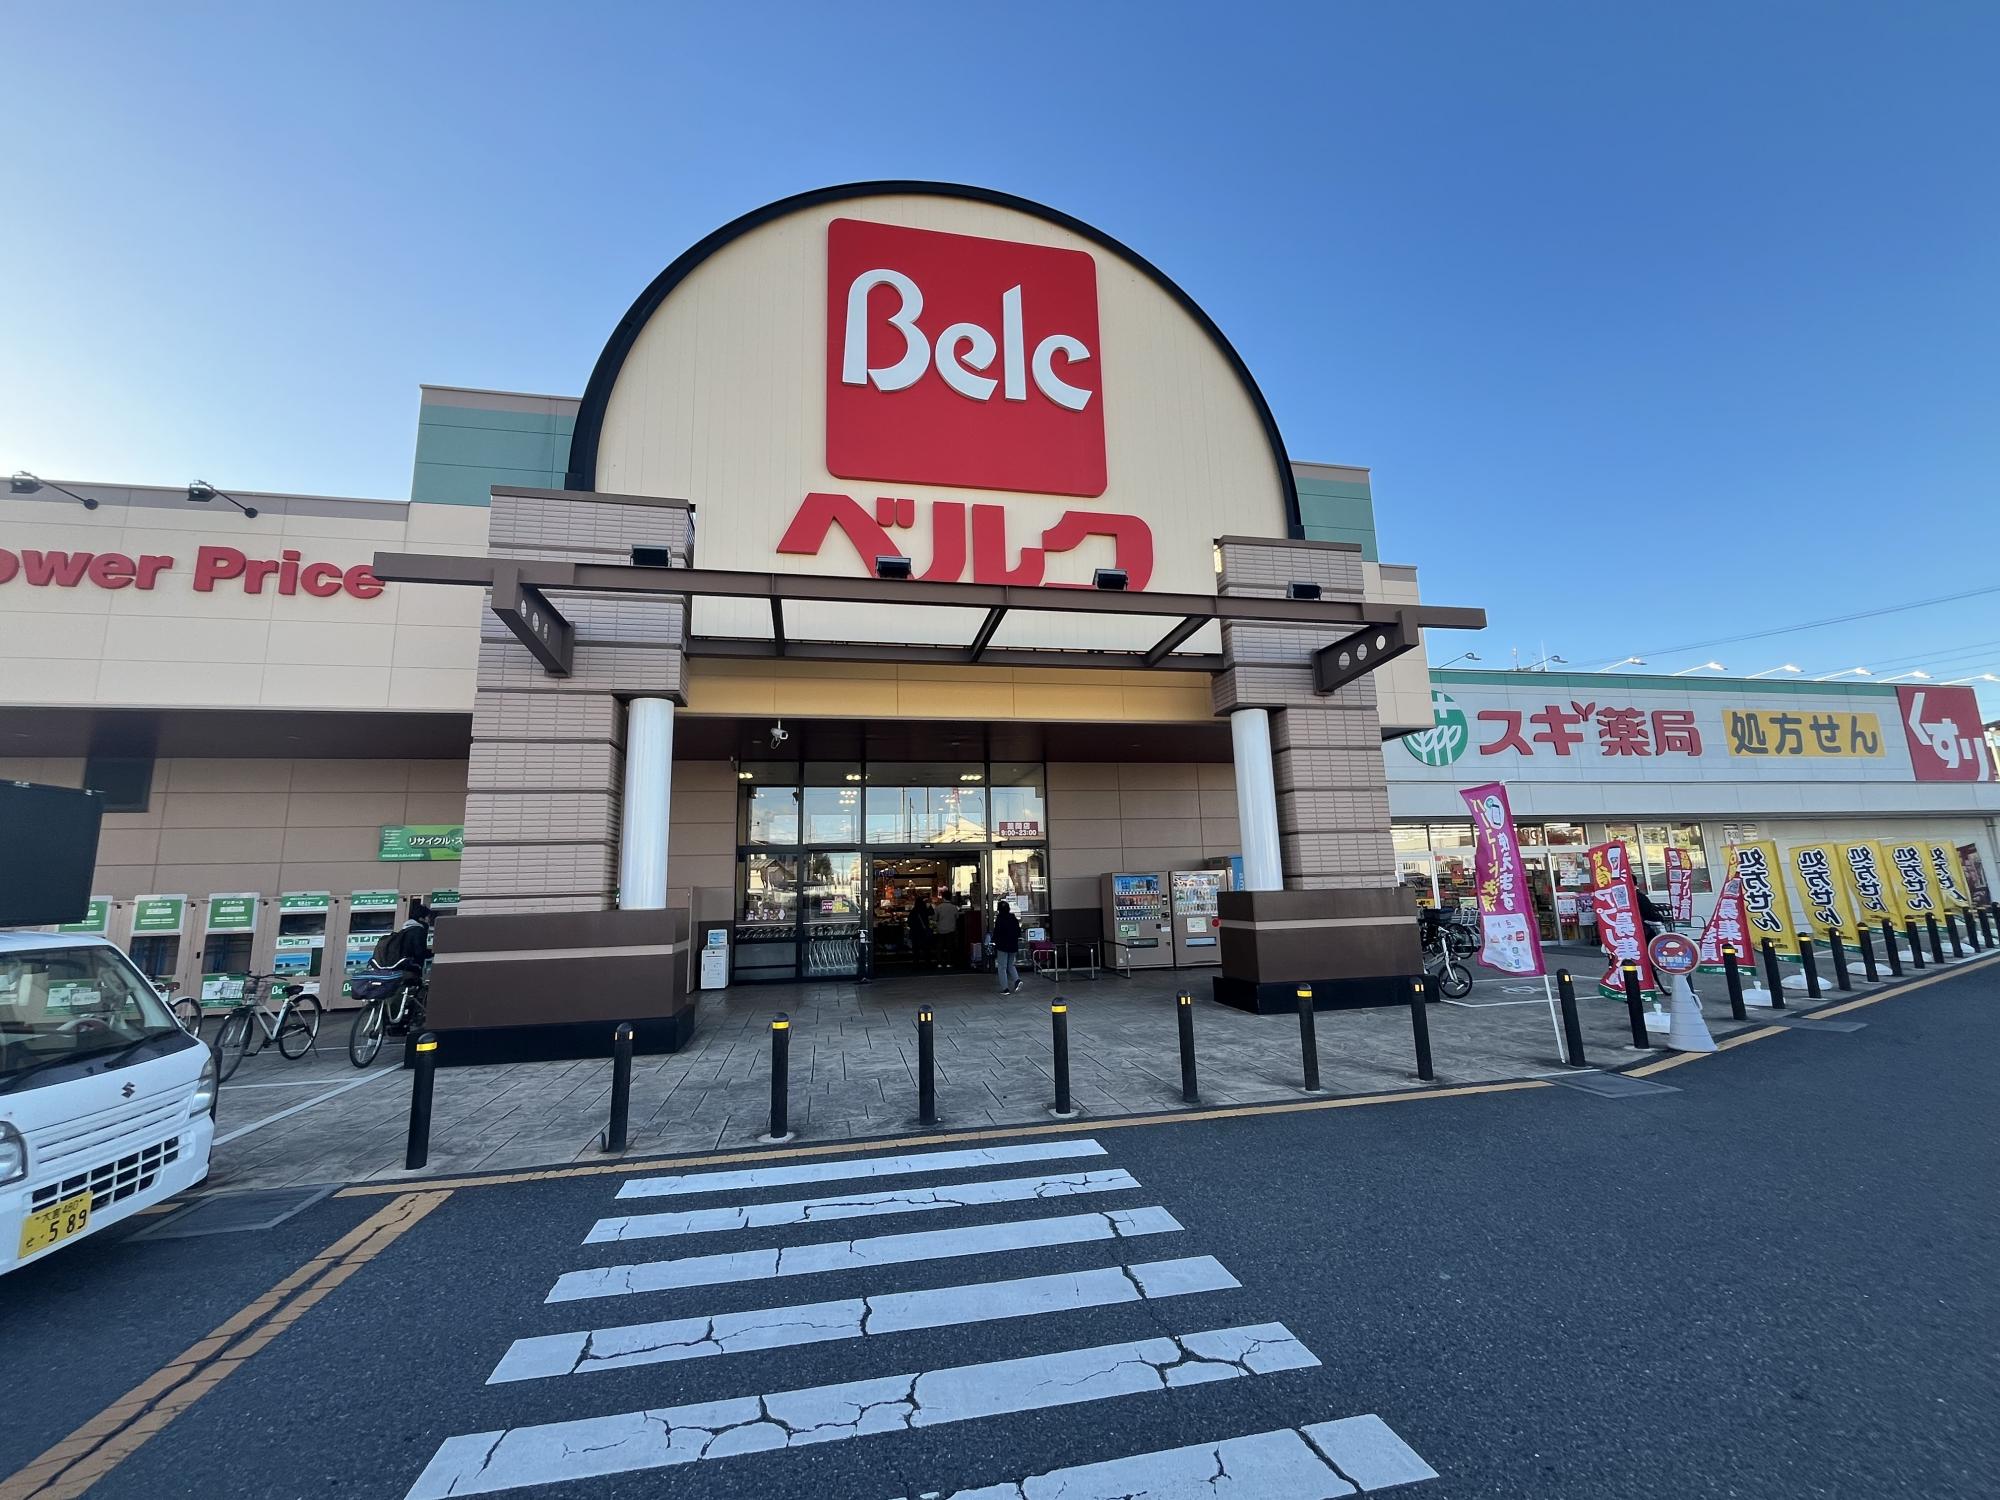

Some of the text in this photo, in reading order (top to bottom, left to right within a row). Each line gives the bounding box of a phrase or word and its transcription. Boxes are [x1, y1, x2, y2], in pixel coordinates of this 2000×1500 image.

[841, 268, 1093, 412] Belc
[193, 545, 387, 600] Price
[776, 492, 1154, 592] ベルク
[1477, 700, 1703, 757] スギ薬局
[1730, 712, 1880, 755] 処方せん
[1907, 692, 1991, 782] くすり
